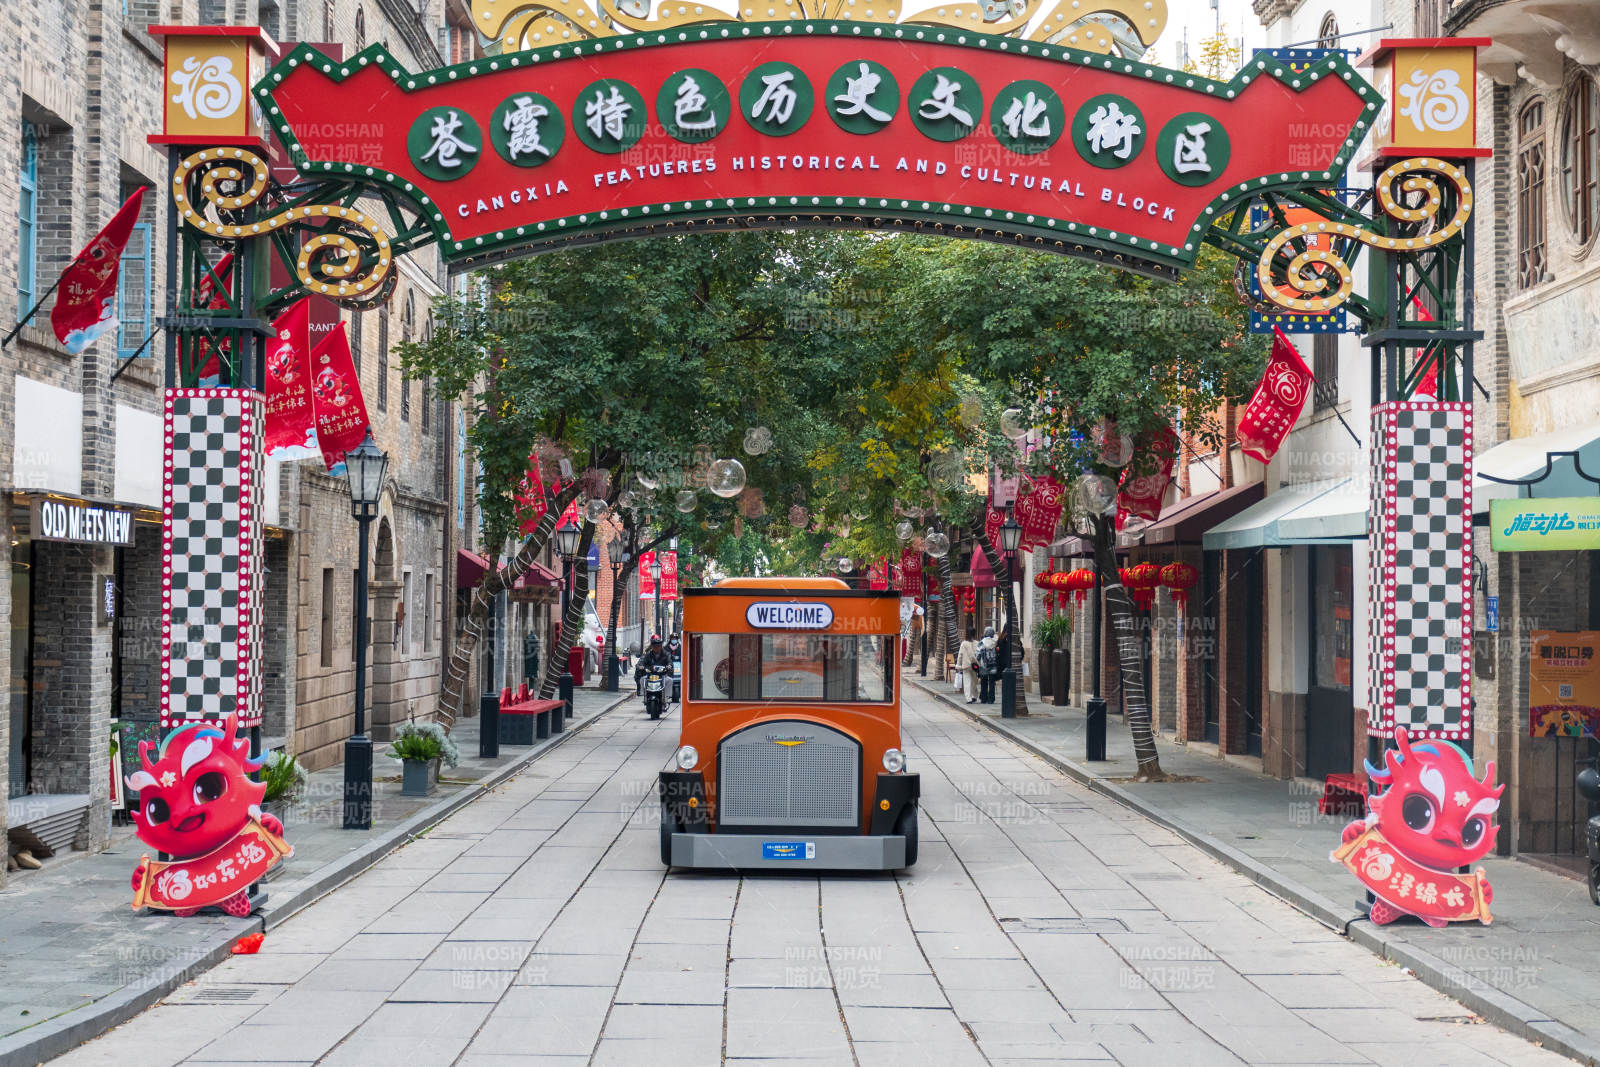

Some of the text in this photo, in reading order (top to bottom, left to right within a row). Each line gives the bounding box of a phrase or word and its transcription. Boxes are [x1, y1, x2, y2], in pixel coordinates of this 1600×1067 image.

[420, 62, 1212, 175] 苍霞特色历史文化街区
[458, 154, 1177, 223] CANGXIA FEATUERES HISTORICAL AND CULTURAL BLOCK
[42, 501, 131, 544] OLD MEETS NEW
[757, 607, 824, 624] WELCOME
[1359, 847, 1466, 907] 福泽绵长
